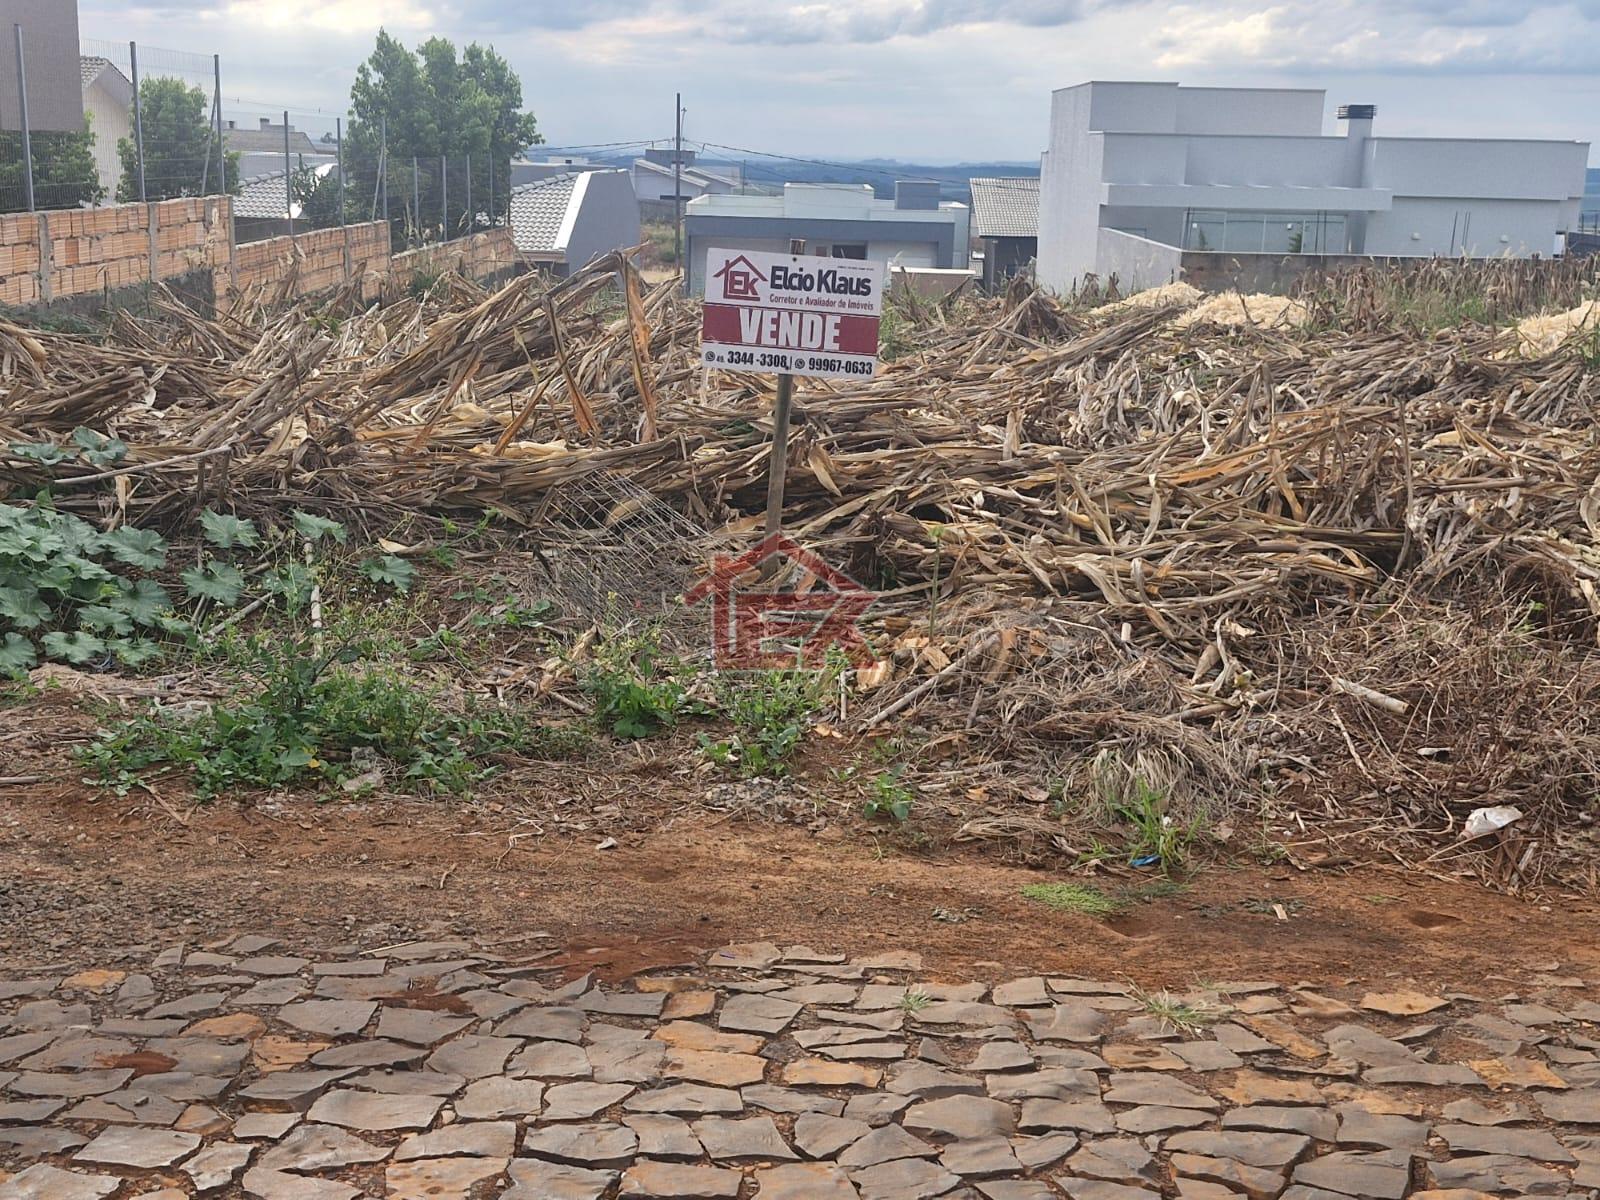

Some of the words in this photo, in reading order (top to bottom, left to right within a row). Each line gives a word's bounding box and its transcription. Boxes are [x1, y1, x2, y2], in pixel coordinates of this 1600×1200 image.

[770, 266, 814, 292] Elcio
[817, 269, 871, 296] Klaus
[769, 293, 797, 304] Corretor
[799, 297, 804, 305] e
[805, 296, 836, 308] Avaliador
[837, 299, 846, 308] de
[848, 299, 874, 311] Imóveis
[739, 308, 841, 350] VENDE
[808, 357, 873, 375] 99967-0633
